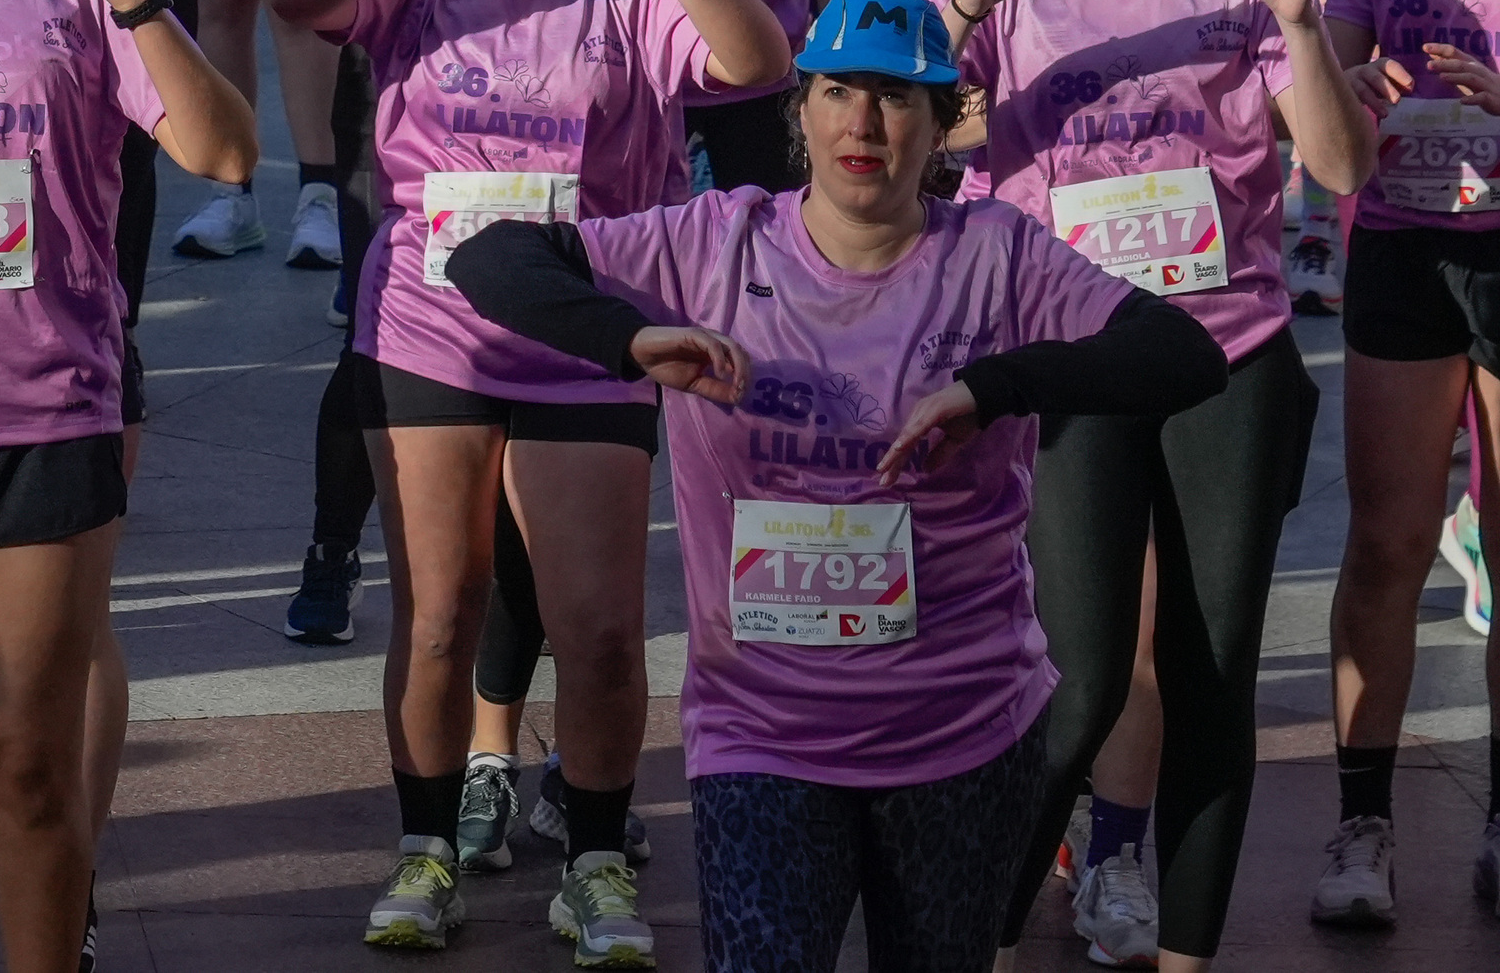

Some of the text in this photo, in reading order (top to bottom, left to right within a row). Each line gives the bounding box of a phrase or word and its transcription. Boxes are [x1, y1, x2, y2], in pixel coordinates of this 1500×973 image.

[855, 1, 908, 33] M
[43, 18, 87, 51] ATLETICO
[438, 63, 500, 102] 36.
[1050, 70, 1118, 105] 36.
[437, 104, 585, 146] LILATON
[1057, 110, 1205, 146] LILATON
[1400, 136, 1498, 168] 2629
[1083, 189, 1141, 209] LILATON
[1089, 208, 1198, 255] 1217
[1111, 251, 1151, 265] BADIOLA
[1196, 270, 1218, 278] VASCO
[752, 377, 828, 426] 36.
[764, 521, 825, 537] LILATON
[764, 551, 889, 591] 1792
[745, 592, 821, 603] KARMELE FABO
[737, 610, 779, 625] ATLETICO
